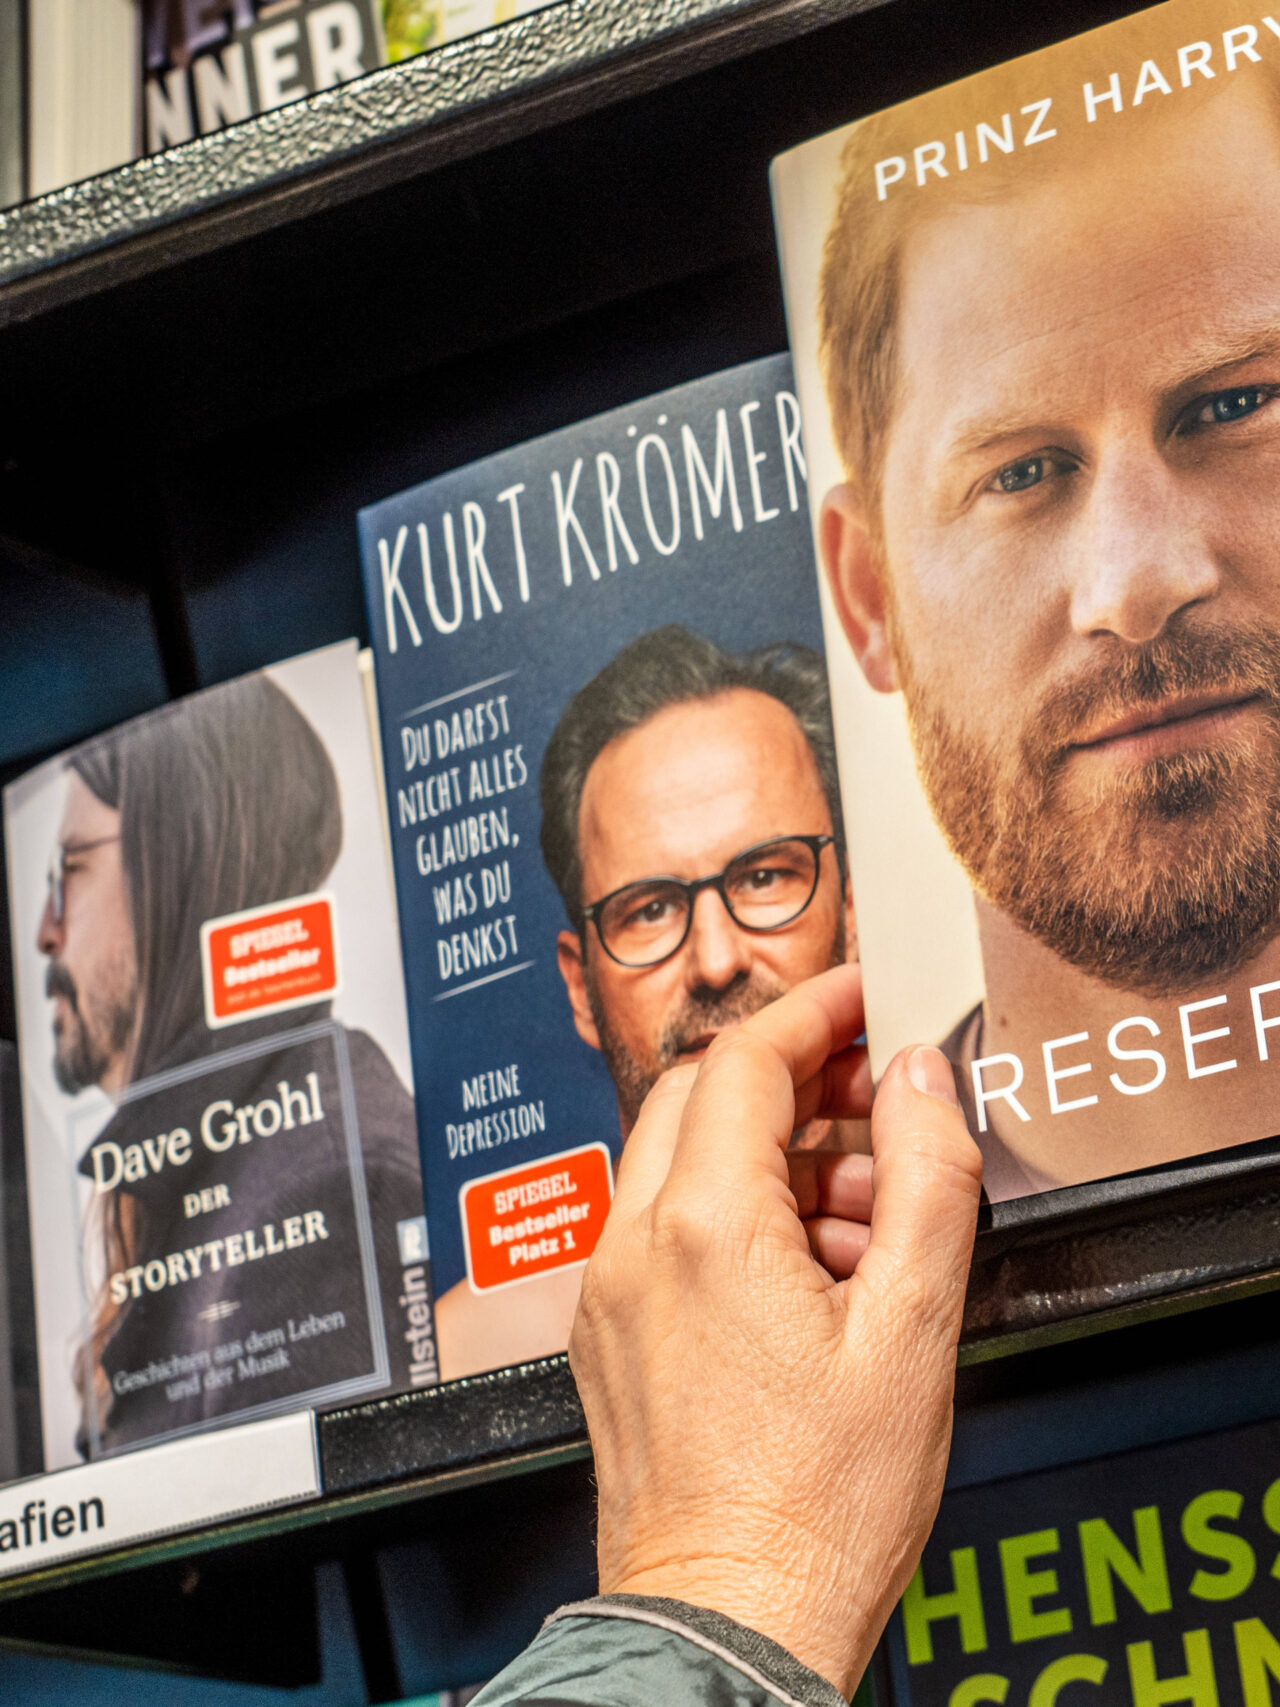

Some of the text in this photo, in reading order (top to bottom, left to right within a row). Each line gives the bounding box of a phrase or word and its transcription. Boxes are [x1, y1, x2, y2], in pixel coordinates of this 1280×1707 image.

[873, 98, 1057, 201] PRINZ
[379, 390, 807, 653] KURT KRÖMER
[401, 695, 510, 772] DU DARFST
[398, 744, 528, 828] NICHT ALLES
[416, 805, 520, 876] GLAUBEN,
[433, 860, 512, 926] WAS DU
[437, 914, 519, 982] DENKST
[462, 1064, 521, 1113] MEINE
[90, 1072, 324, 1193] Dave Grohl
[445, 1101, 546, 1160] DEPRESSION
[183, 1184, 231, 1218] DER
[489, 1200, 591, 1247] Bestseller
[493, 1170, 577, 1216] SPIEGEL
[109, 1210, 329, 1304] STORYTELLER
[509, 1231, 576, 1267] Platz 1
[113, 1310, 346, 1395] Geschichten aus dem Leben
[165, 1347, 291, 1401] und der Musik
